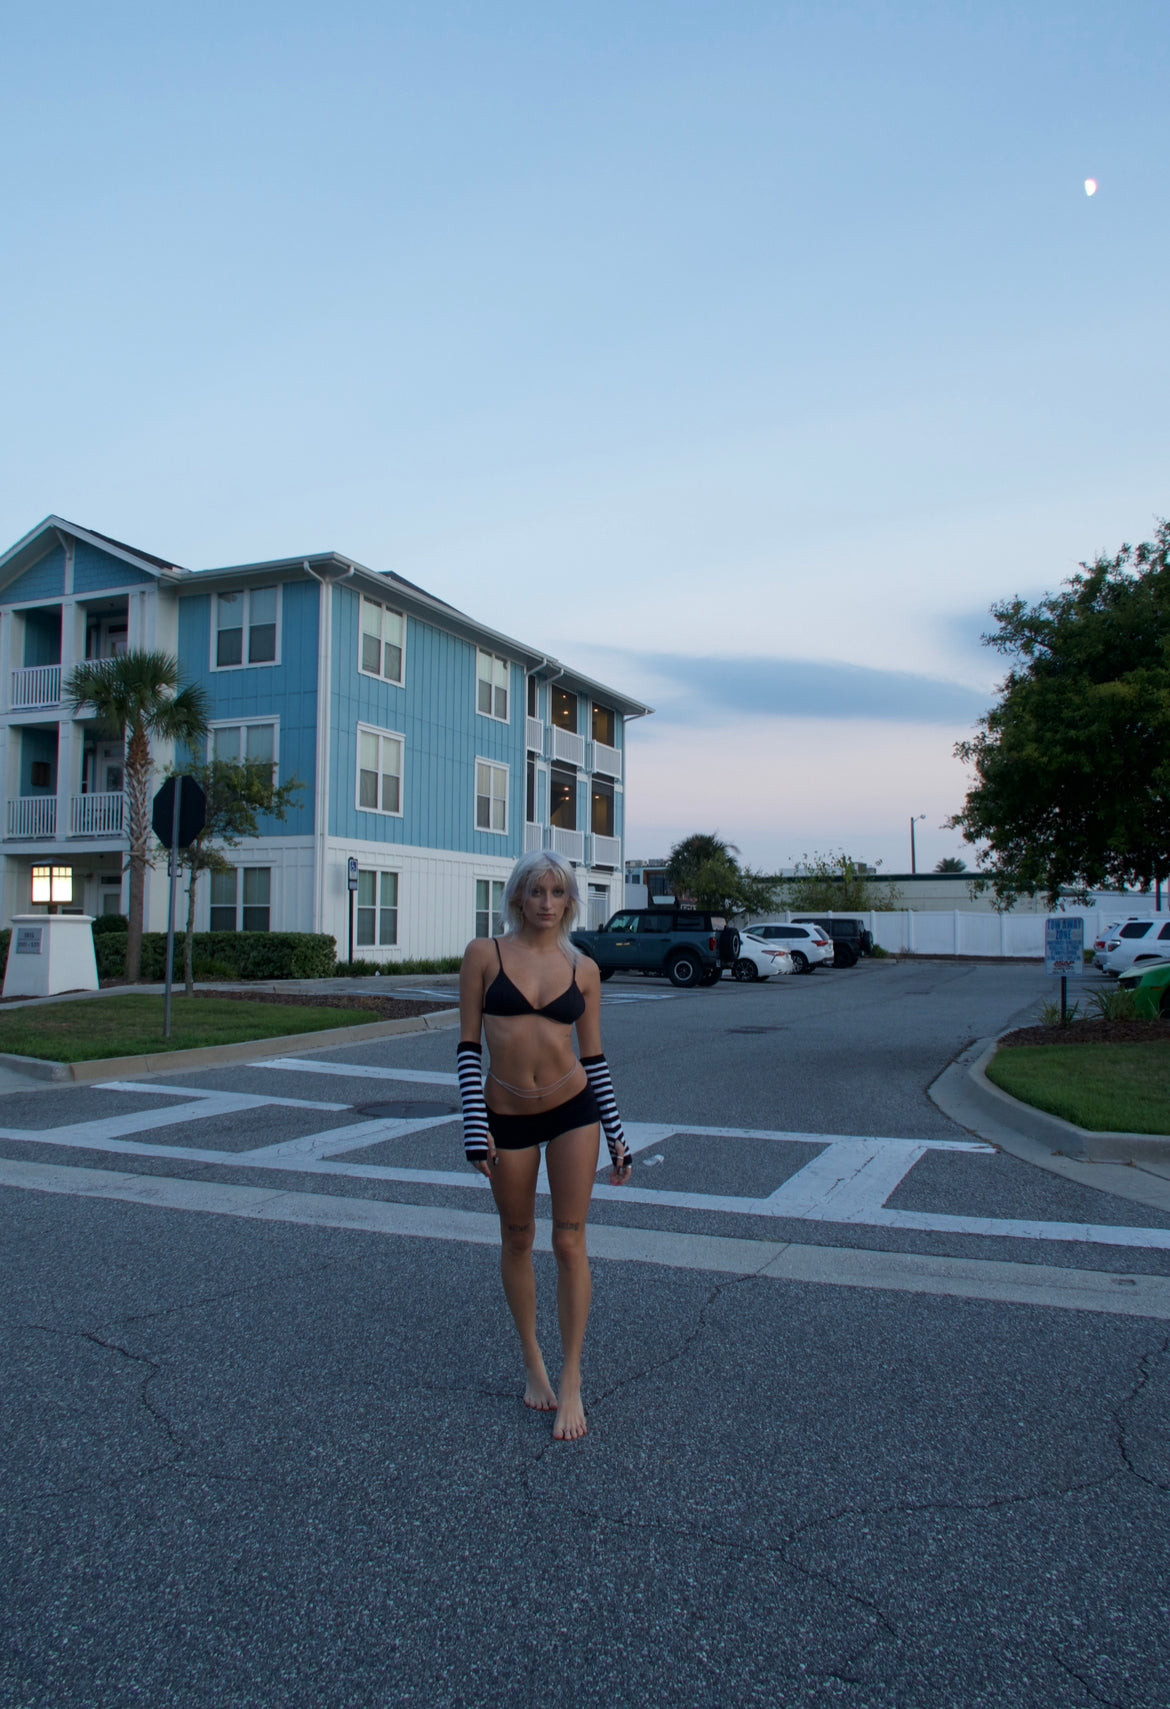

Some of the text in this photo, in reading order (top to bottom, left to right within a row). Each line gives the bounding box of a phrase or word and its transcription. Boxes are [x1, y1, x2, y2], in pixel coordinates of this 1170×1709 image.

[1047, 920, 1080, 930] TOW AWAY
[1056, 930, 1071, 940] ZONE
